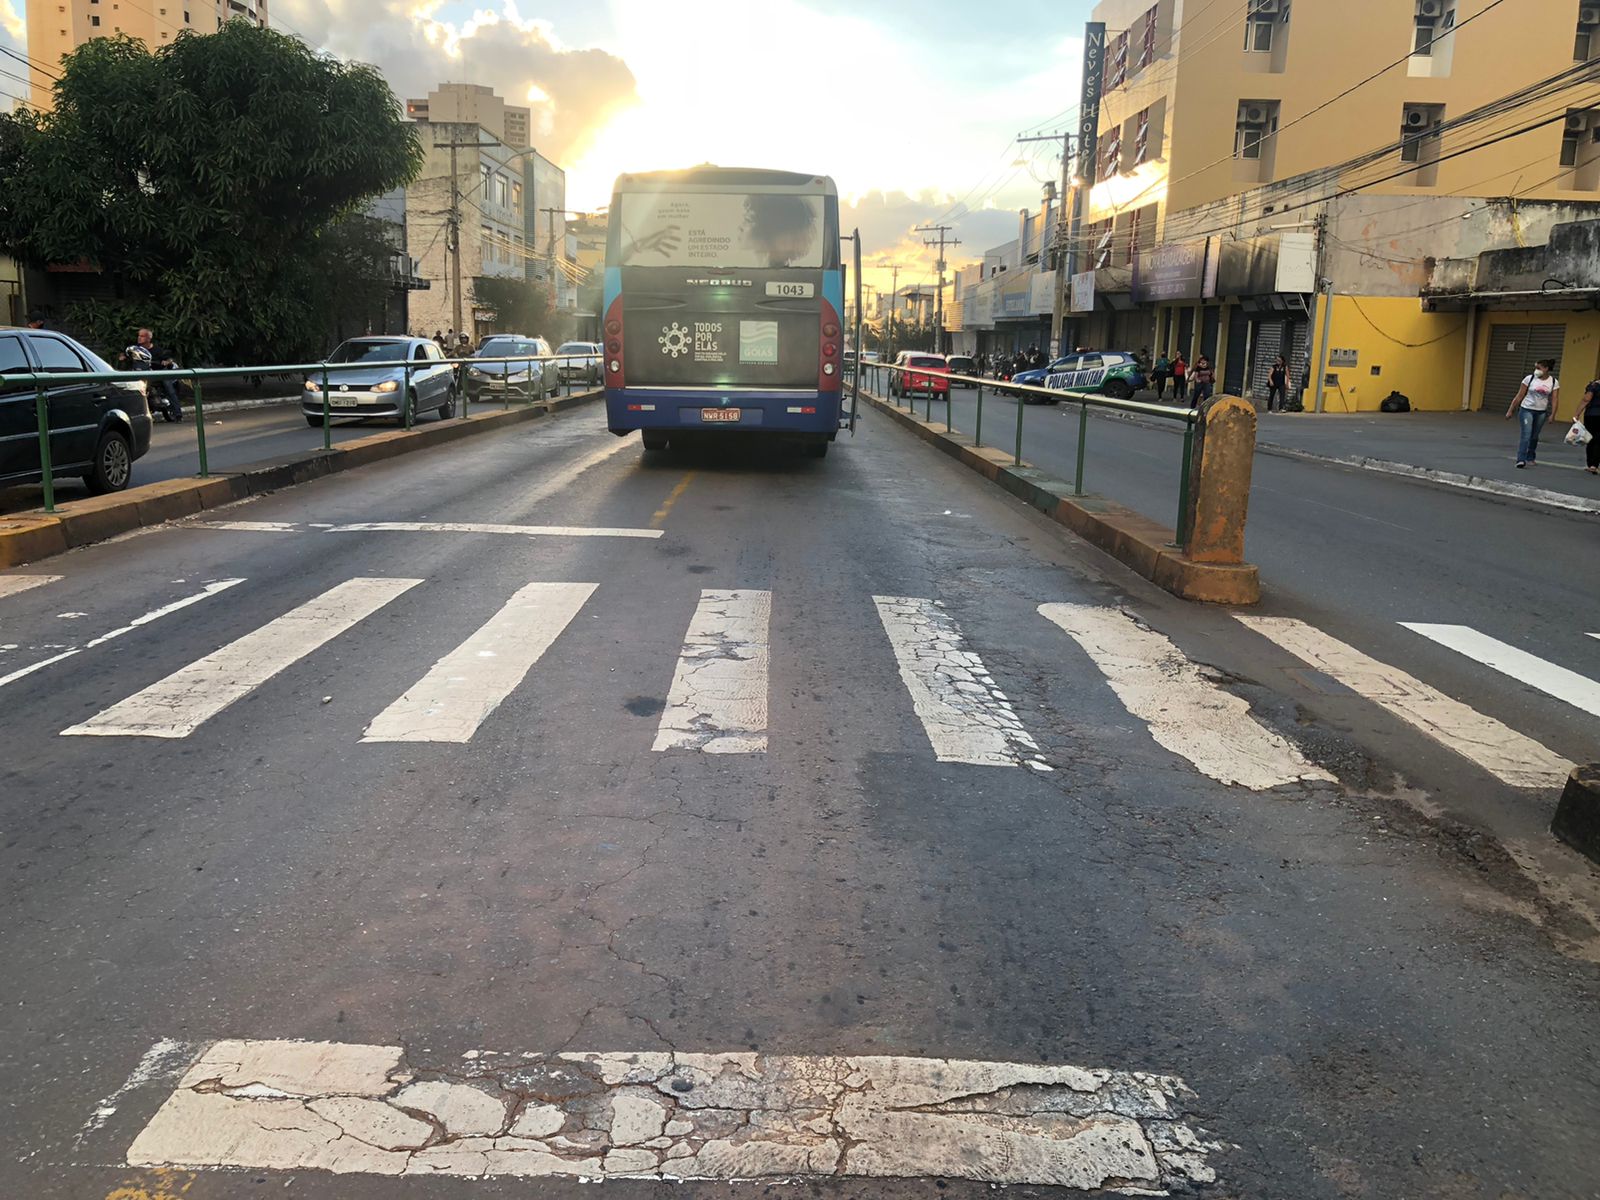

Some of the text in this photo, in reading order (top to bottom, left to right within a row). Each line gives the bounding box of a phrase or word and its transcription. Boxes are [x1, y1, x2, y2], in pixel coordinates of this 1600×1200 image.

[1081, 103, 1095, 177] Hotel
[777, 284, 804, 296] 1043
[694, 322, 722, 332] TODOS
[695, 332, 712, 342] POR
[695, 342, 718, 351] ELAS
[1074, 369, 1105, 387] MILITAR
